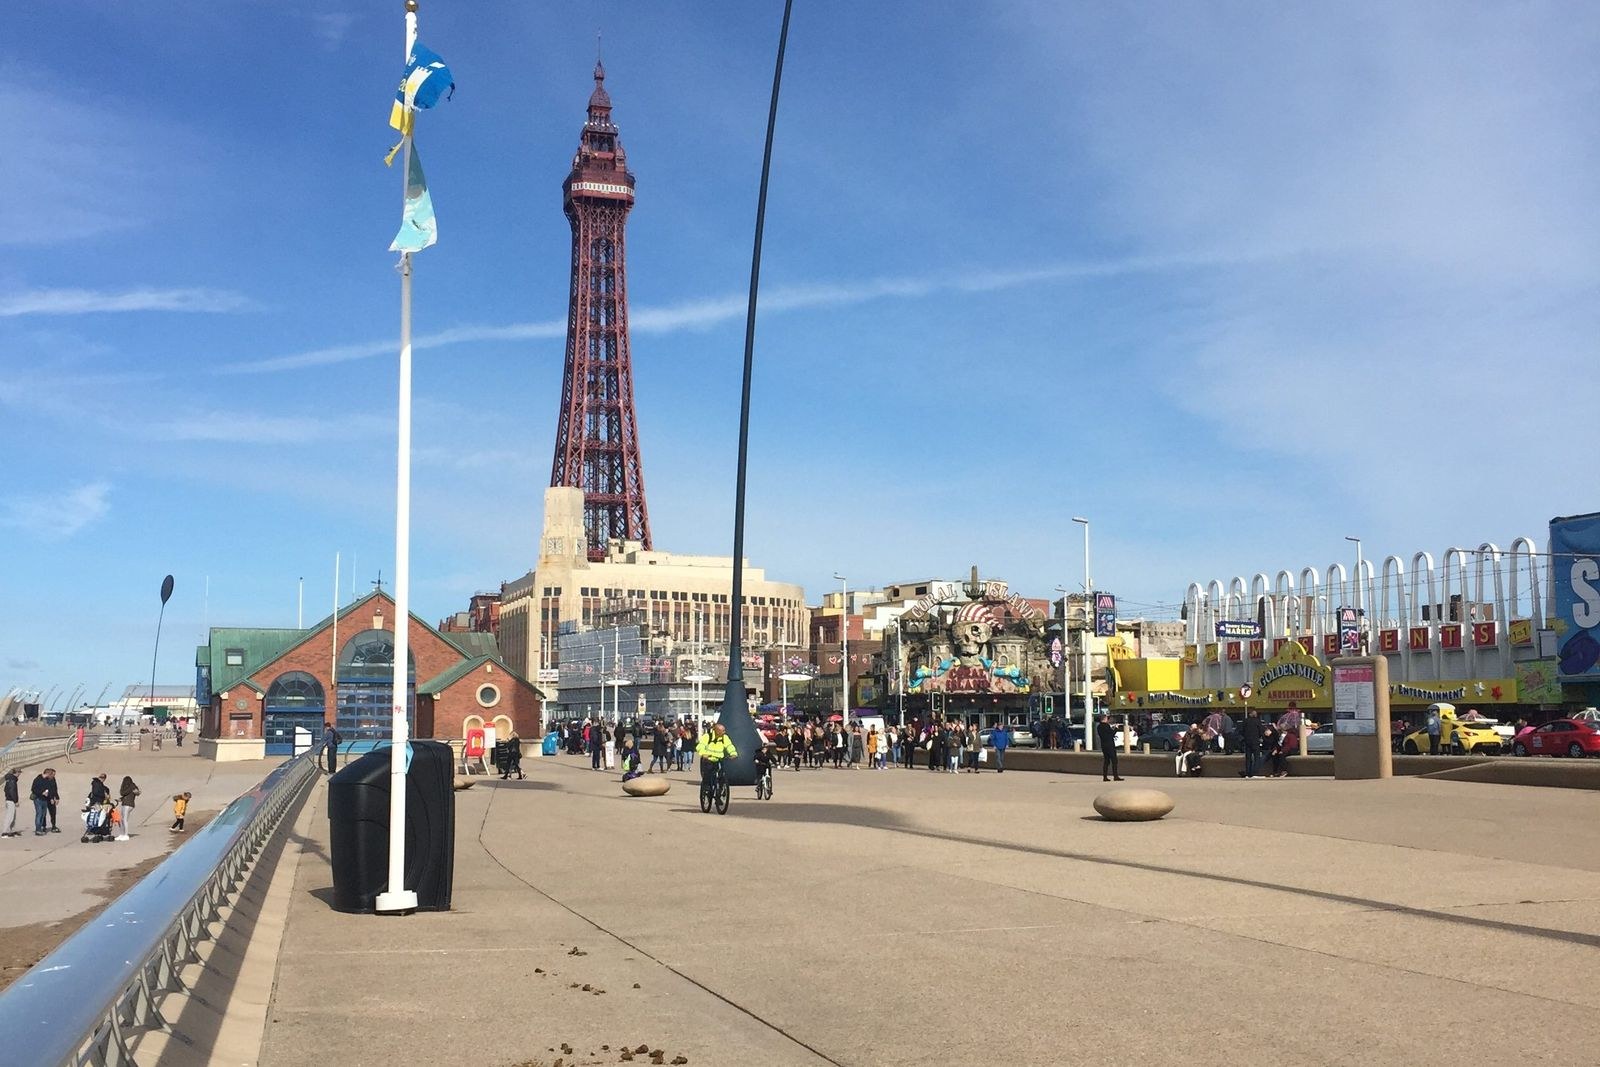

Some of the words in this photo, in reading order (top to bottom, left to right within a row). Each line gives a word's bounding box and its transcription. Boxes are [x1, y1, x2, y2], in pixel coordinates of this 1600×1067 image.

[911, 584, 957, 618] CORAL
[985, 581, 1035, 619] ISLAND
[1225, 628, 1255, 636] MARKET
[1229, 625, 1489, 658] AMSEENTS
[1259, 663, 1297, 688] GOLDEN
[1296, 663, 1325, 687] MILE
[1398, 683, 1466, 700] ENTERTAINMENT
